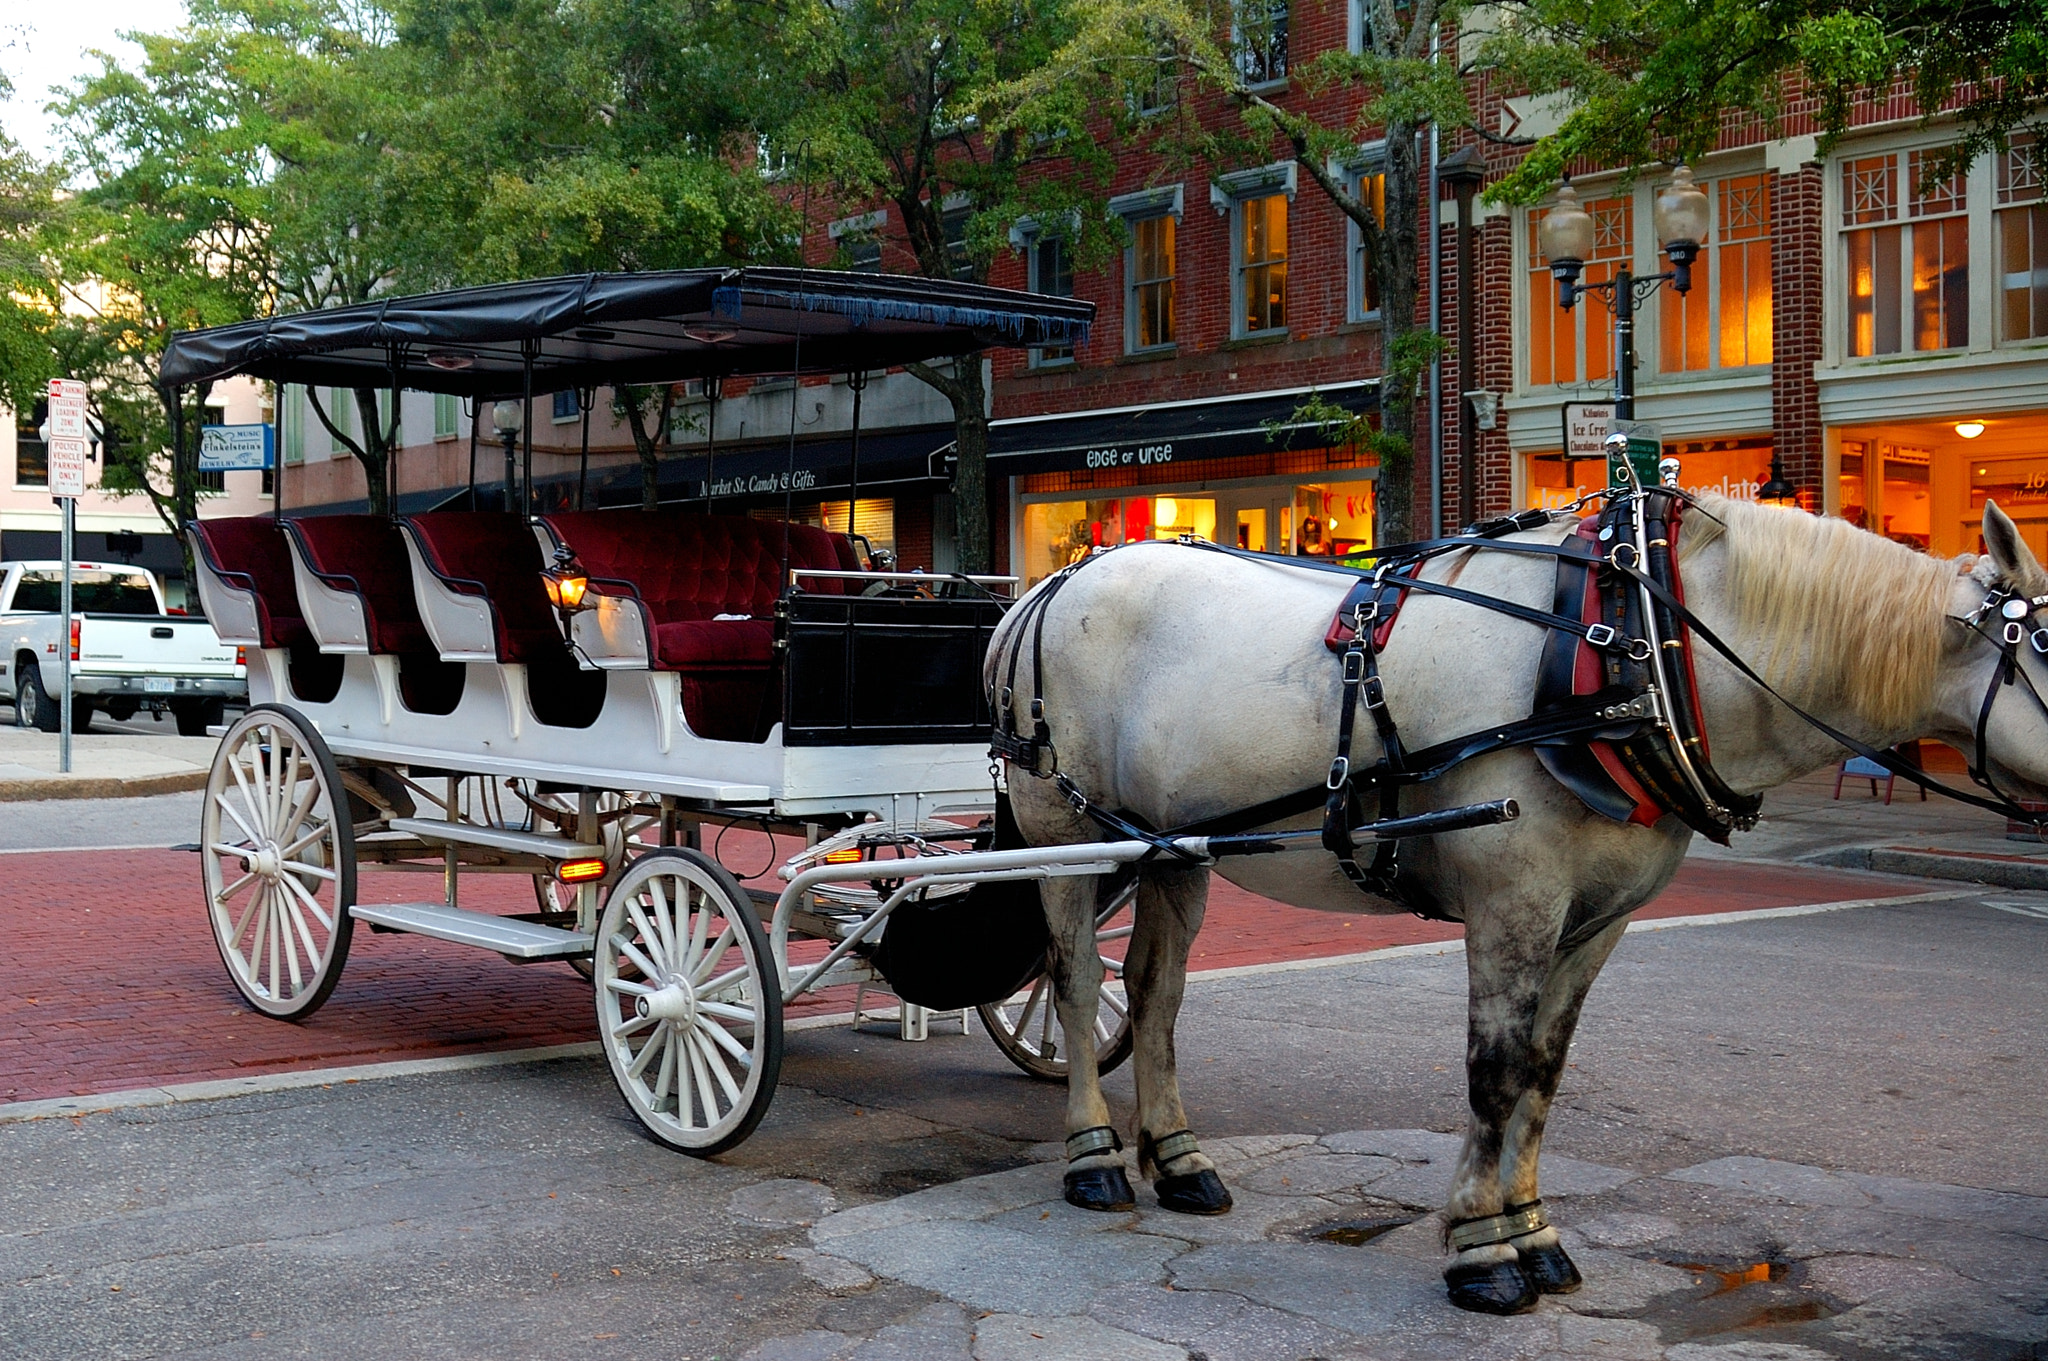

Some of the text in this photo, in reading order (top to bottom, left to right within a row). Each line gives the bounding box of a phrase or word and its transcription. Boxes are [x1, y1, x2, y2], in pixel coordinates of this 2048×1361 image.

[52, 398, 83, 407] PASSENGER
[56, 408, 79, 417] LOADING
[60, 418, 74, 427] ZONE
[236, 430, 261, 438] MUSIC
[1573, 422, 1586, 436] Ice
[1588, 422, 1607, 437] Cre
[54, 441, 79, 451] POLICE
[203, 442, 261, 452] Finkelstein's
[53, 452, 81, 461] VEHICLE
[53, 461, 82, 471] PARKING
[59, 471, 76, 481] ONLY
[733, 476, 746, 494] St.
[748, 473, 778, 493] Candy
[780, 472, 790, 489] &
[792, 470, 816, 490] Gifts
